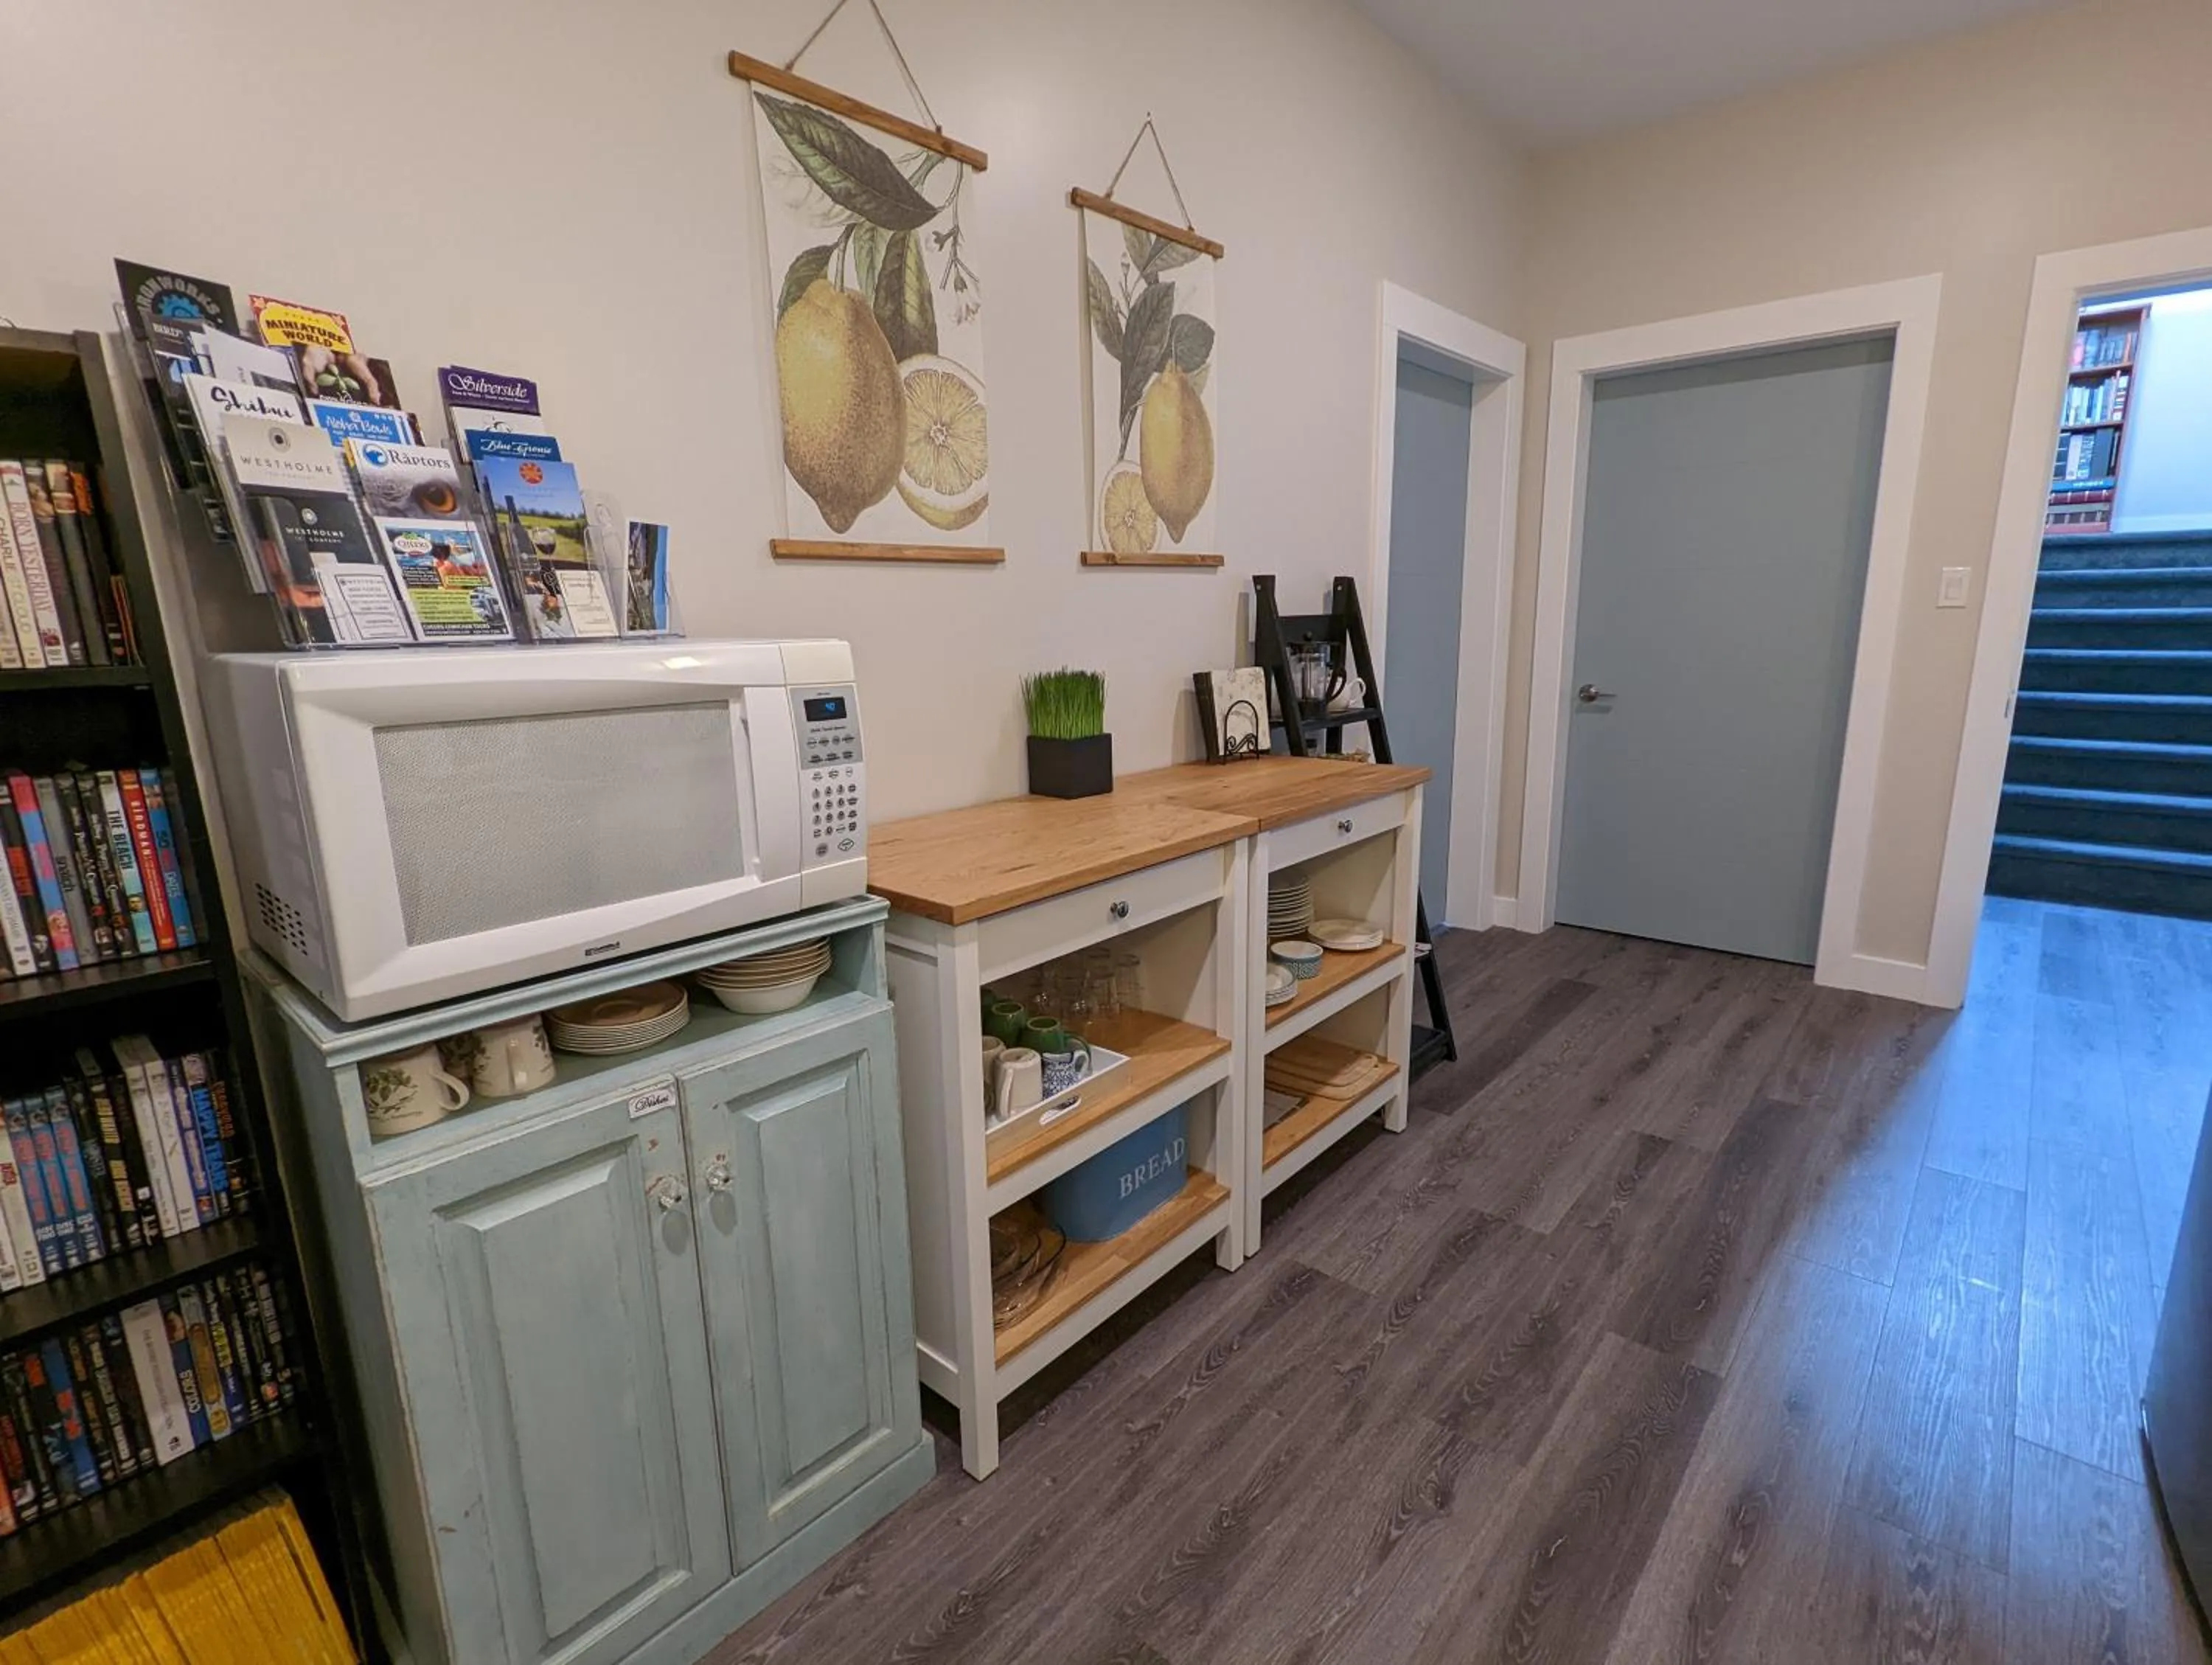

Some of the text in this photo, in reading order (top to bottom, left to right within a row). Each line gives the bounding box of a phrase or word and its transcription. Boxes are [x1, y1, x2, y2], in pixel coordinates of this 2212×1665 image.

[265, 319, 345, 344] MINIATURE
[282, 330, 333, 347] WORLD
[448, 373, 527, 398] Silverside
[481, 439, 512, 452] Blue
[240, 455, 333, 474] WESTHOLME
[285, 527, 344, 538] WESTHOLME
[107, 810, 133, 869] THE BEACH
[131, 800, 152, 855] BIRDMAN
[1118, 1137, 1186, 1200] BREAD
